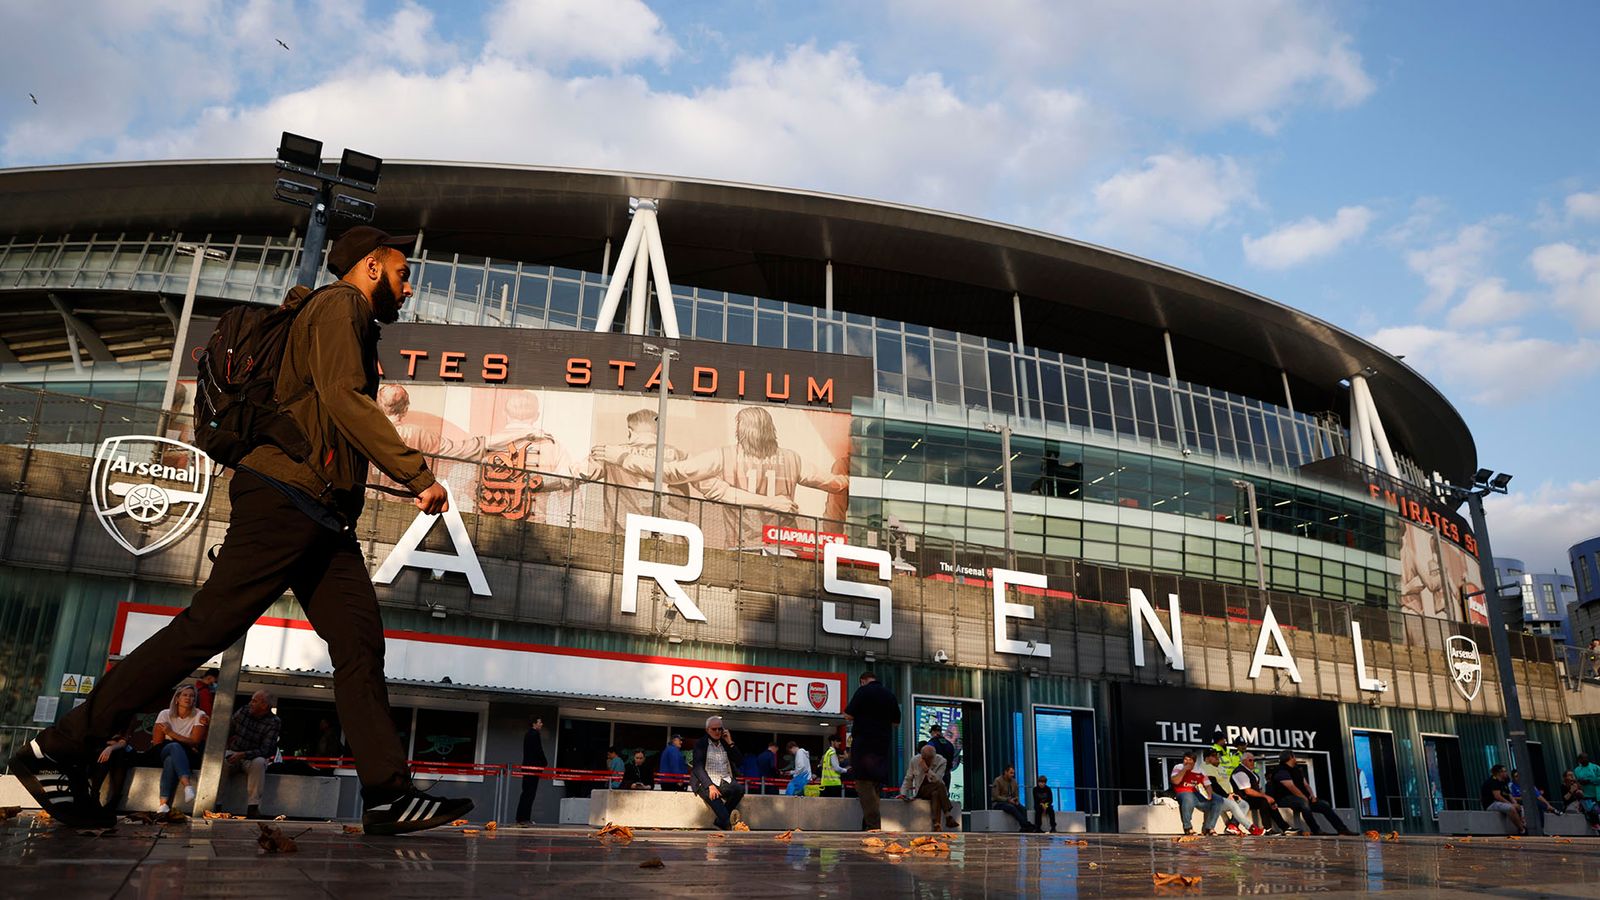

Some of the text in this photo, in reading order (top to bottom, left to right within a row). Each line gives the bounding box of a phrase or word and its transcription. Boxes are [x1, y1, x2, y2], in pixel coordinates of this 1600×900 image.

[378, 349, 834, 404] TES STADIUM
[110, 456, 196, 483] Arsenal
[940, 561, 985, 577] The Arsenal
[671, 674, 798, 705] BOX OFFICE
[1155, 721, 1203, 743] THE
